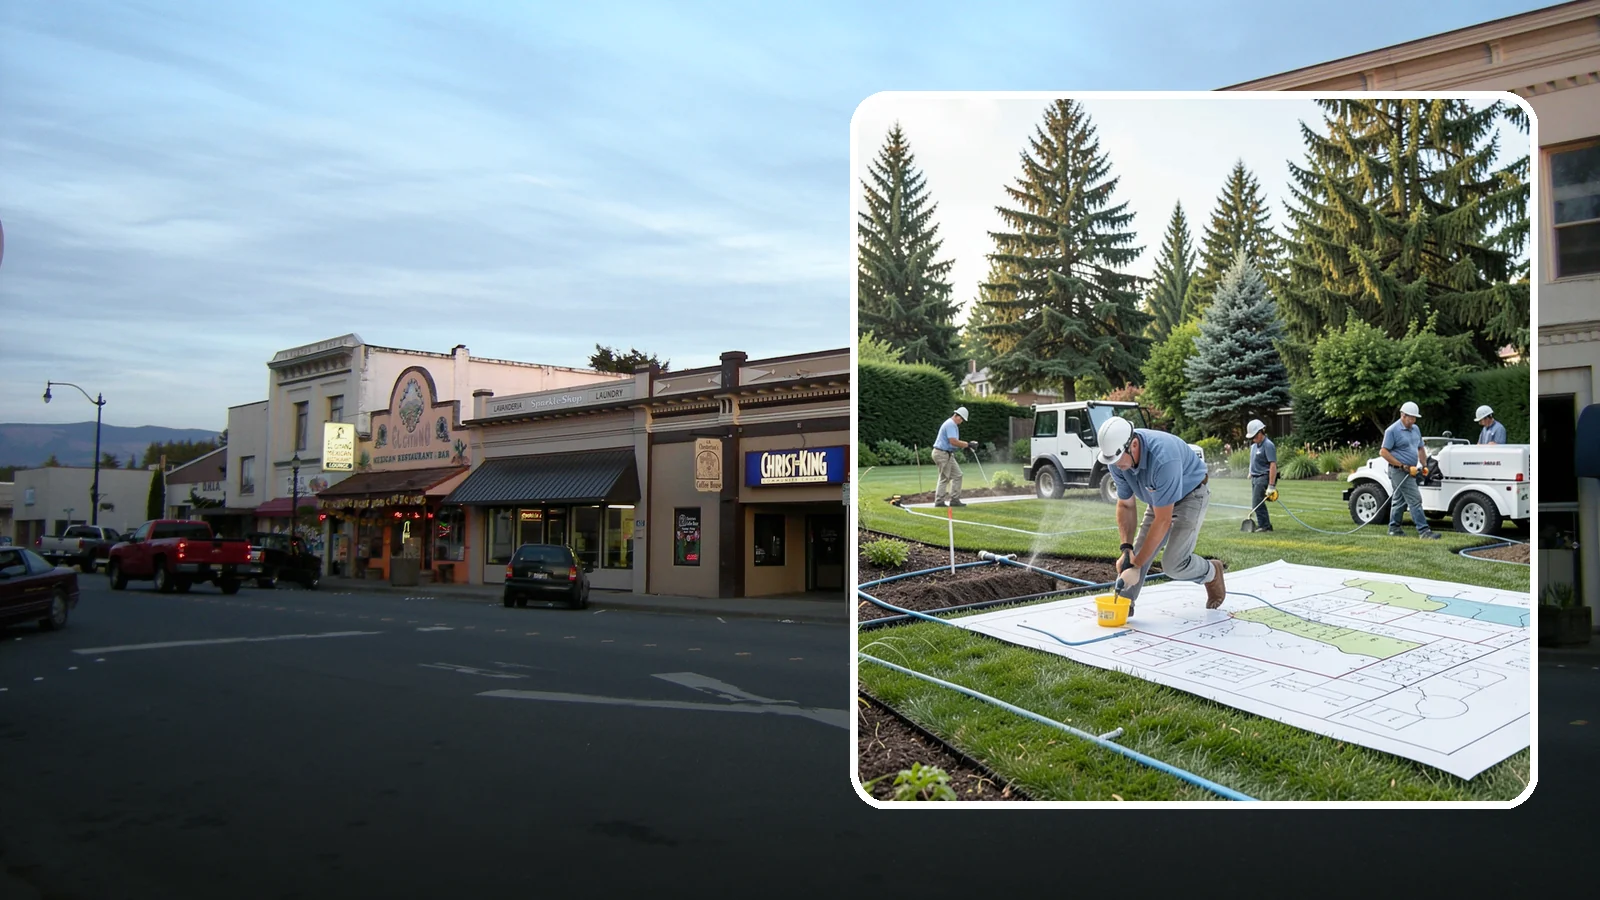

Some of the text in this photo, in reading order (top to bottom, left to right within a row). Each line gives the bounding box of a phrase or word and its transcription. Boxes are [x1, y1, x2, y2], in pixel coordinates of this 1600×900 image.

[493, 402, 522, 412] LAVANDERIA
[561, 395, 582, 405] Shop
[595, 389, 623, 400] LAUNDRY
[373, 455, 396, 464] MEXICAN
[397, 451, 433, 462] RESTAURANT
[438, 450, 450, 459] BAR
[761, 450, 827, 477] CHRIST KING
[697, 481, 709, 489] Coffee
